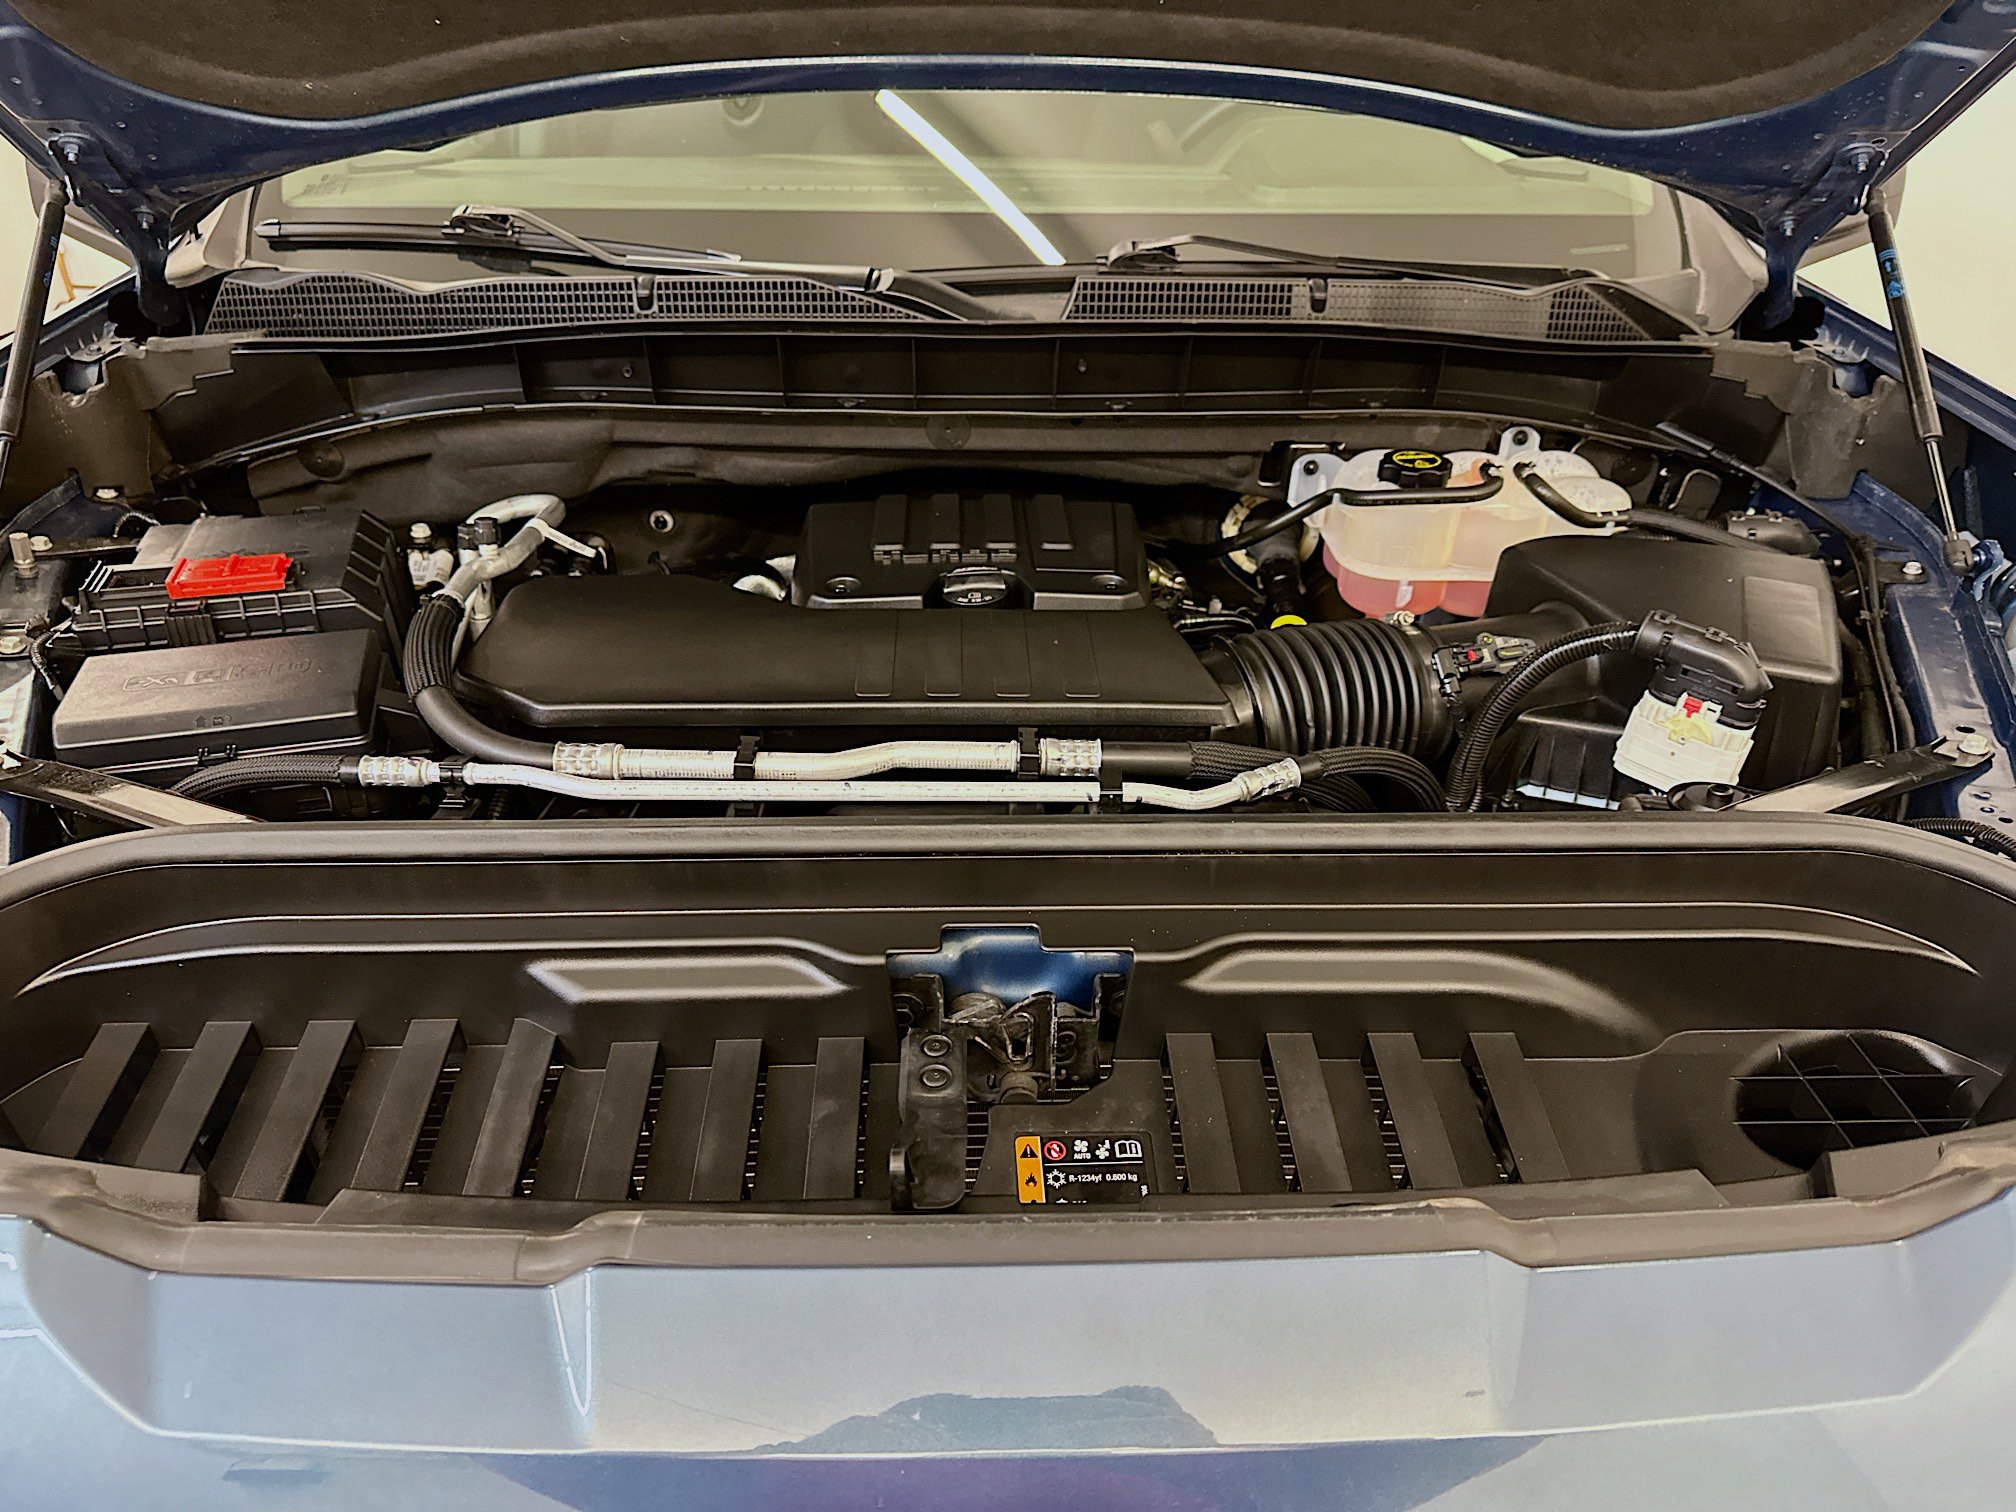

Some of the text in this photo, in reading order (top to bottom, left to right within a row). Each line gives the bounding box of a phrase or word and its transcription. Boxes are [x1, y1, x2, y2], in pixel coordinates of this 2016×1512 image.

[1073, 1152, 1092, 1160] AUTO
[1068, 1173, 1102, 1183] R-1234yf
[1127, 1172, 1138, 1182] kg
